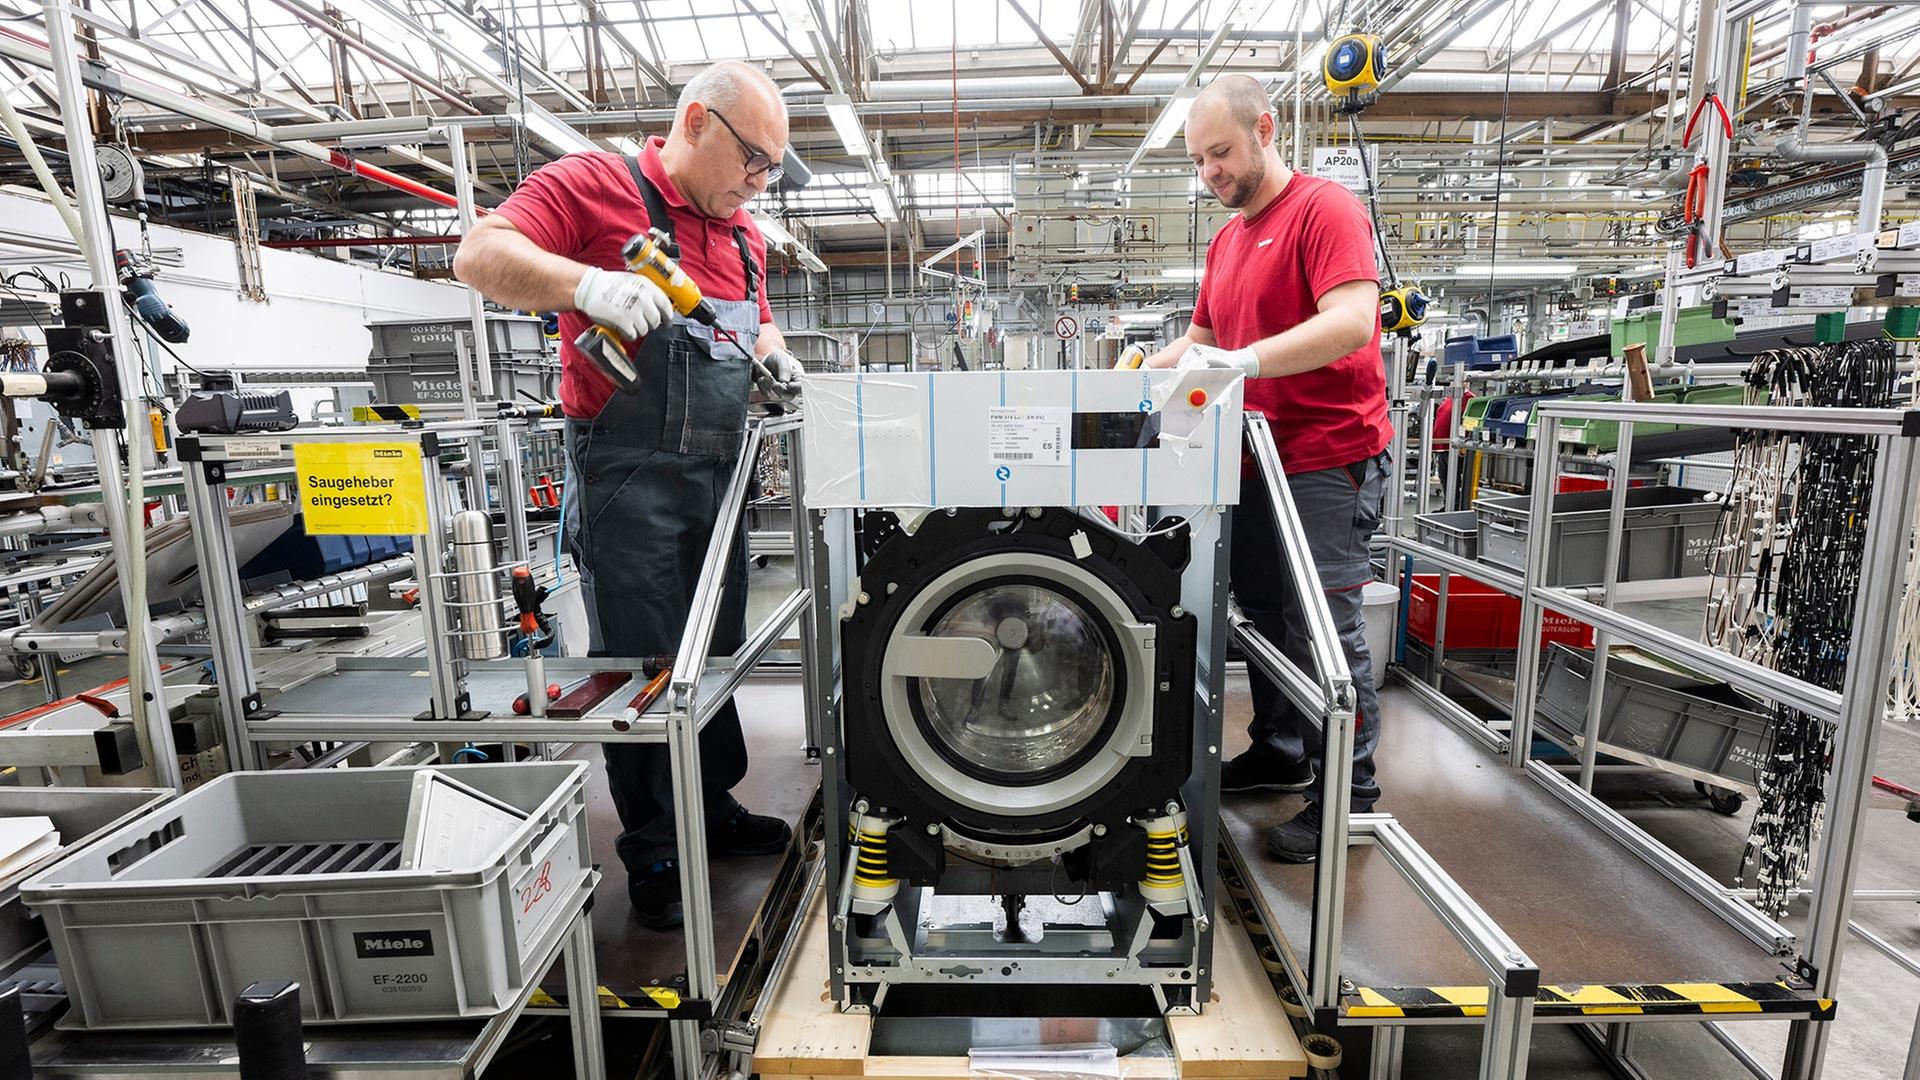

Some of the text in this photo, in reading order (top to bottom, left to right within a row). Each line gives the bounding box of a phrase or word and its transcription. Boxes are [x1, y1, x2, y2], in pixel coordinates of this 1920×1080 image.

[1324, 156, 1359, 166] AP20a
[410, 324, 453, 334] EF-3100
[412, 334, 454, 343] Miele
[411, 380, 462, 391] Miele
[416, 391, 461, 400] EF-3100
[1042, 442, 1053, 450] ES
[374, 450, 402, 458] Miele
[308, 475, 395, 491] Saugeheber
[311, 493, 393, 509] eingesetzt?
[520, 861, 552, 913] 228
[363, 938, 424, 950] Miele
[372, 973, 428, 985] EF-2200
